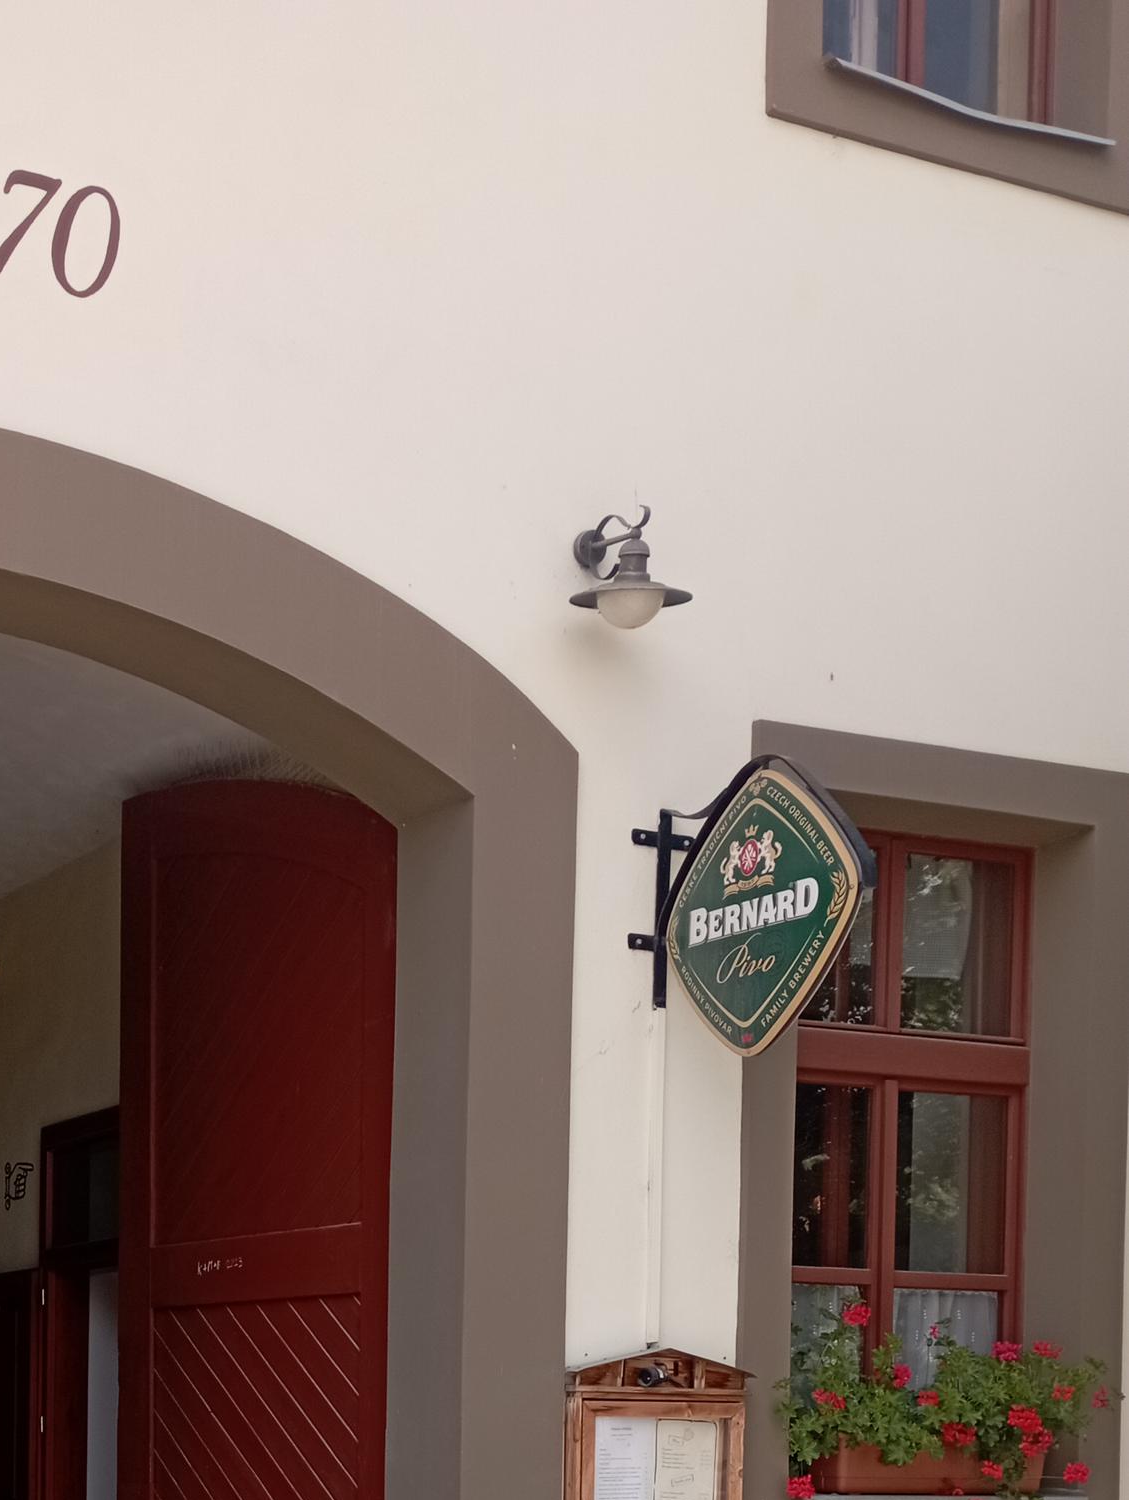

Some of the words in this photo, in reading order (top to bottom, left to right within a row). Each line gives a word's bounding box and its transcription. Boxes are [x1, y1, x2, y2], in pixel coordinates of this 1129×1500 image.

[766, 786, 791, 809] CZECH
[789, 805, 819, 843] ORIGINAL
[817, 840, 835, 866] BEER
[687, 877, 819, 948] BERNARD
[716, 933, 775, 983] Pivo
[760, 989, 789, 1027] FAMILY
[788, 930, 824, 989] BREWERY
[705, 1002, 732, 1036] PIVOVAR
